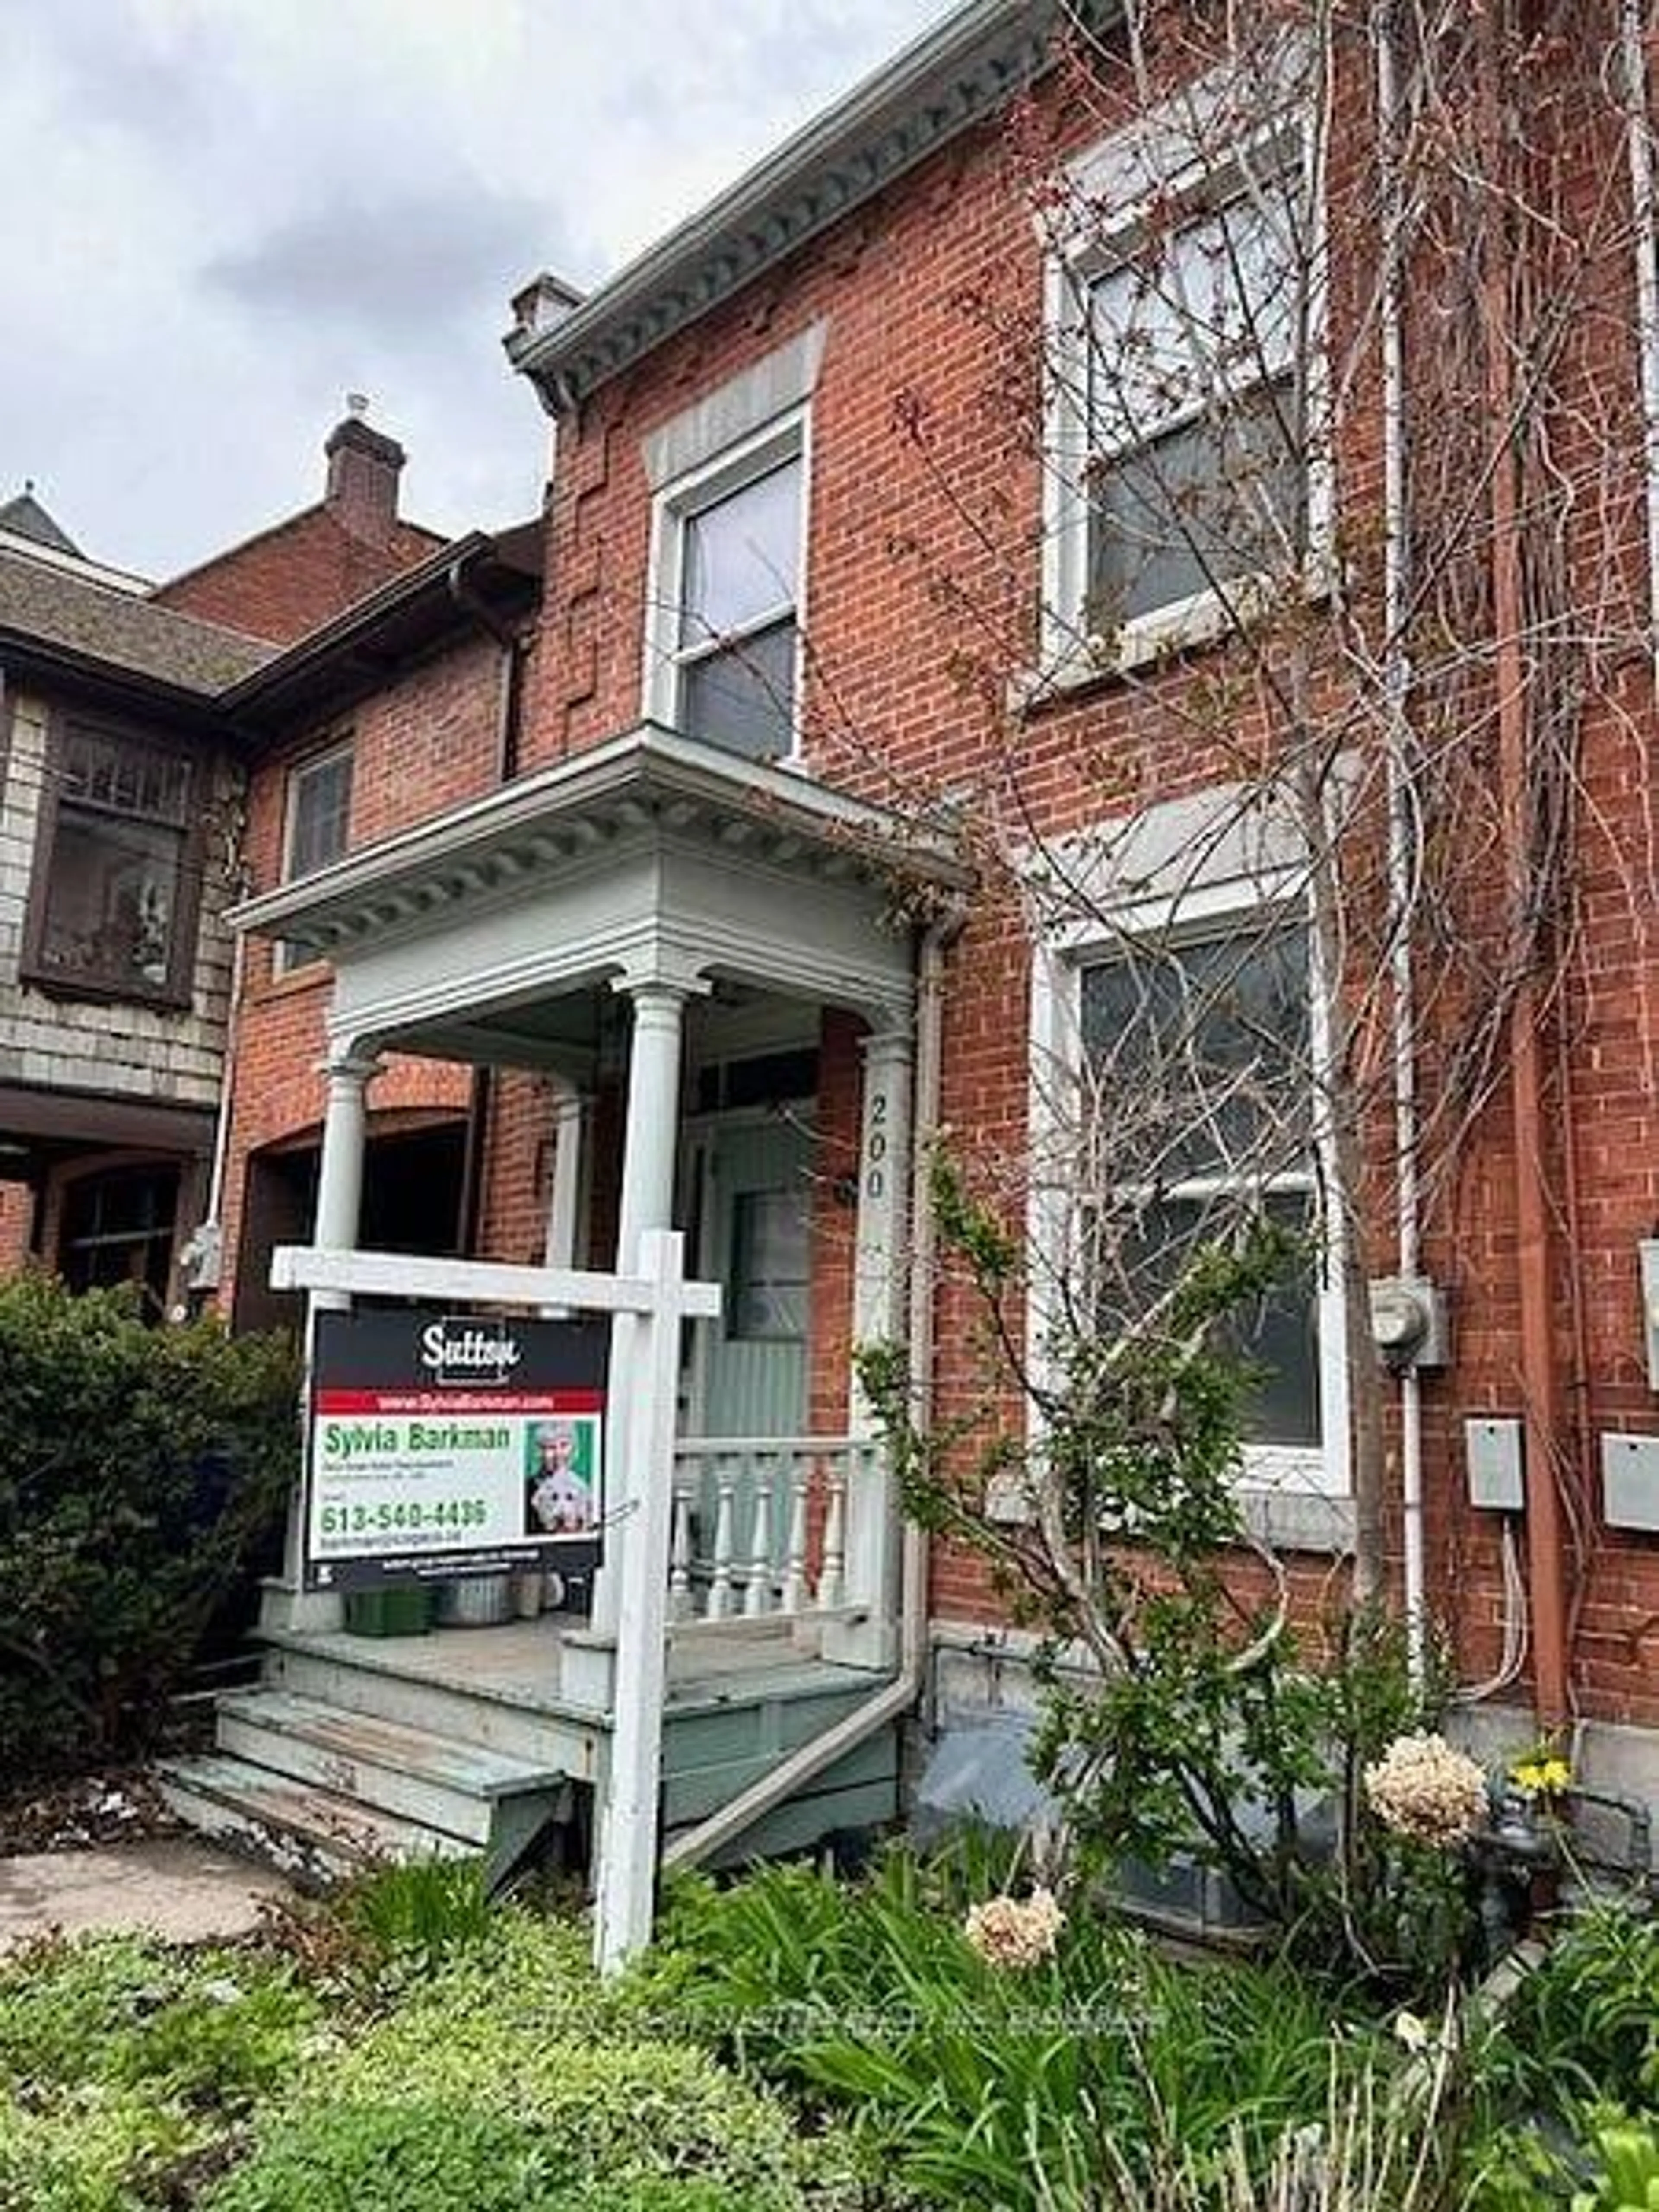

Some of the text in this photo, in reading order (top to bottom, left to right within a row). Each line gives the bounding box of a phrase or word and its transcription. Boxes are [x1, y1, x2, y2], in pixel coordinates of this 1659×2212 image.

[867, 1094, 887, 1198] 200
[422, 1325, 520, 1368] Sutton
[325, 1421, 511, 1459] Sylvia Barkman
